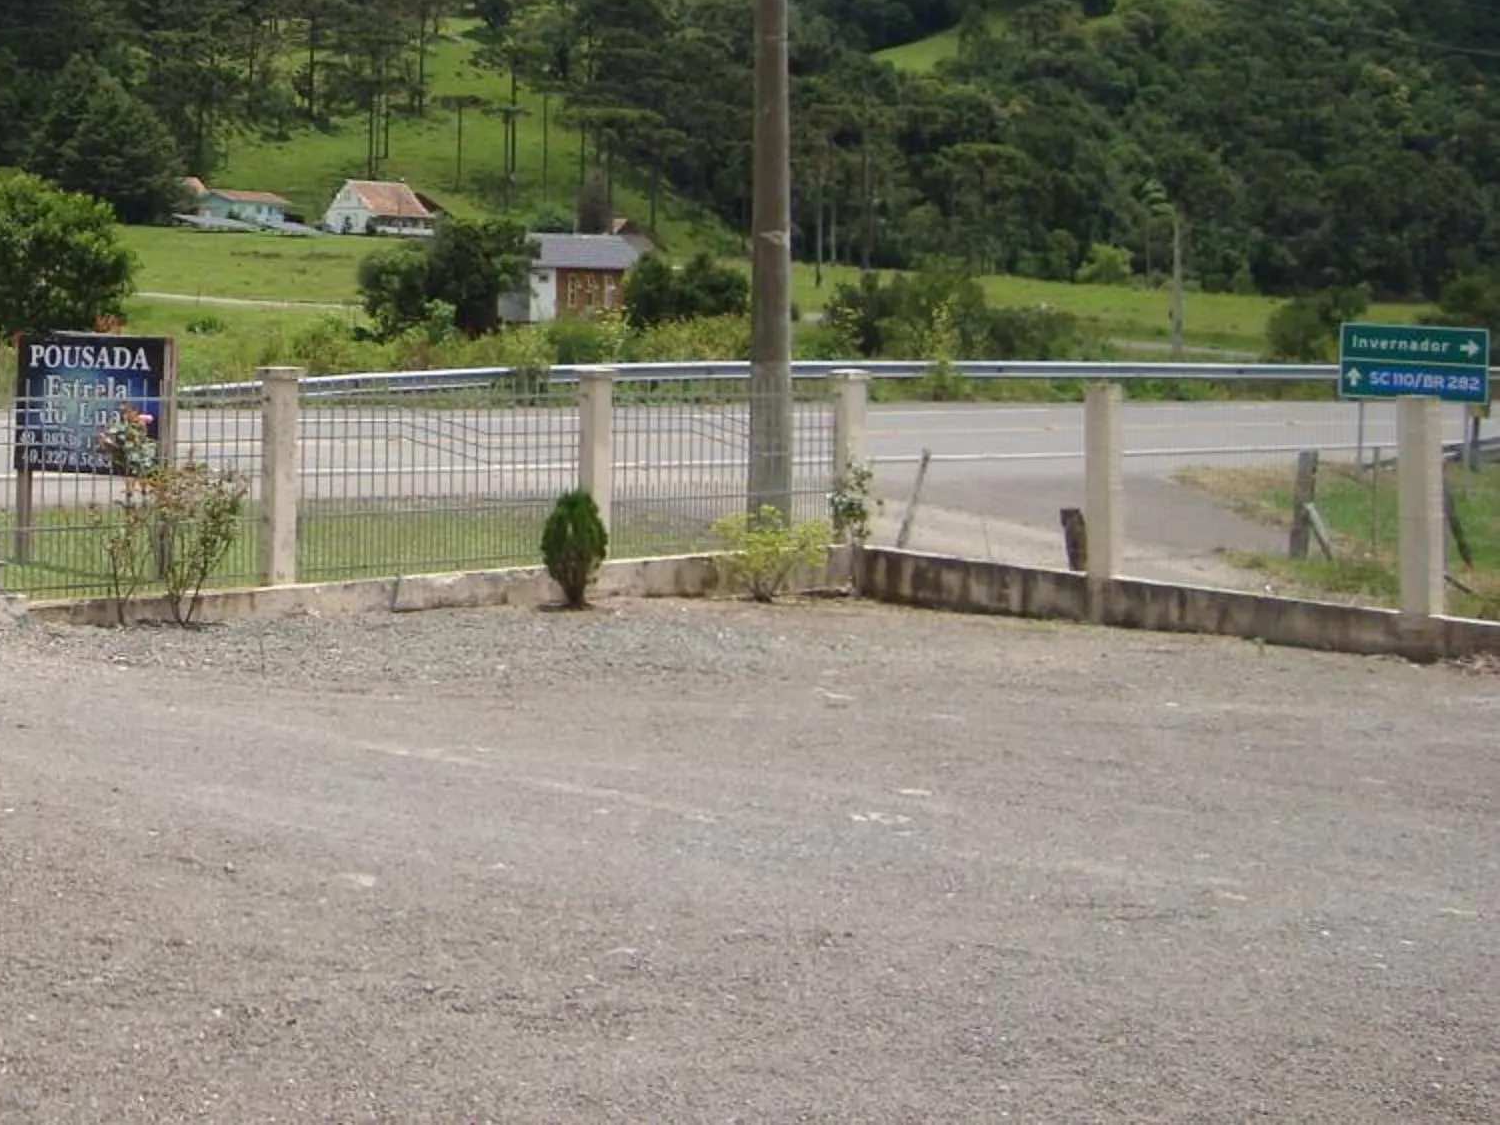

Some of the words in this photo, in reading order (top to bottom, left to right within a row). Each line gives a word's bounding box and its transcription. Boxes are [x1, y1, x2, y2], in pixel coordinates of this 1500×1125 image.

[1351, 334, 1450, 352] Invernador
[29, 344, 151, 370] POUSADA
[44, 375, 128, 400] Estrela
[1369, 371, 1391, 385] SC
[1447, 375, 1480, 392] 282
[78, 402, 130, 426] Lua
